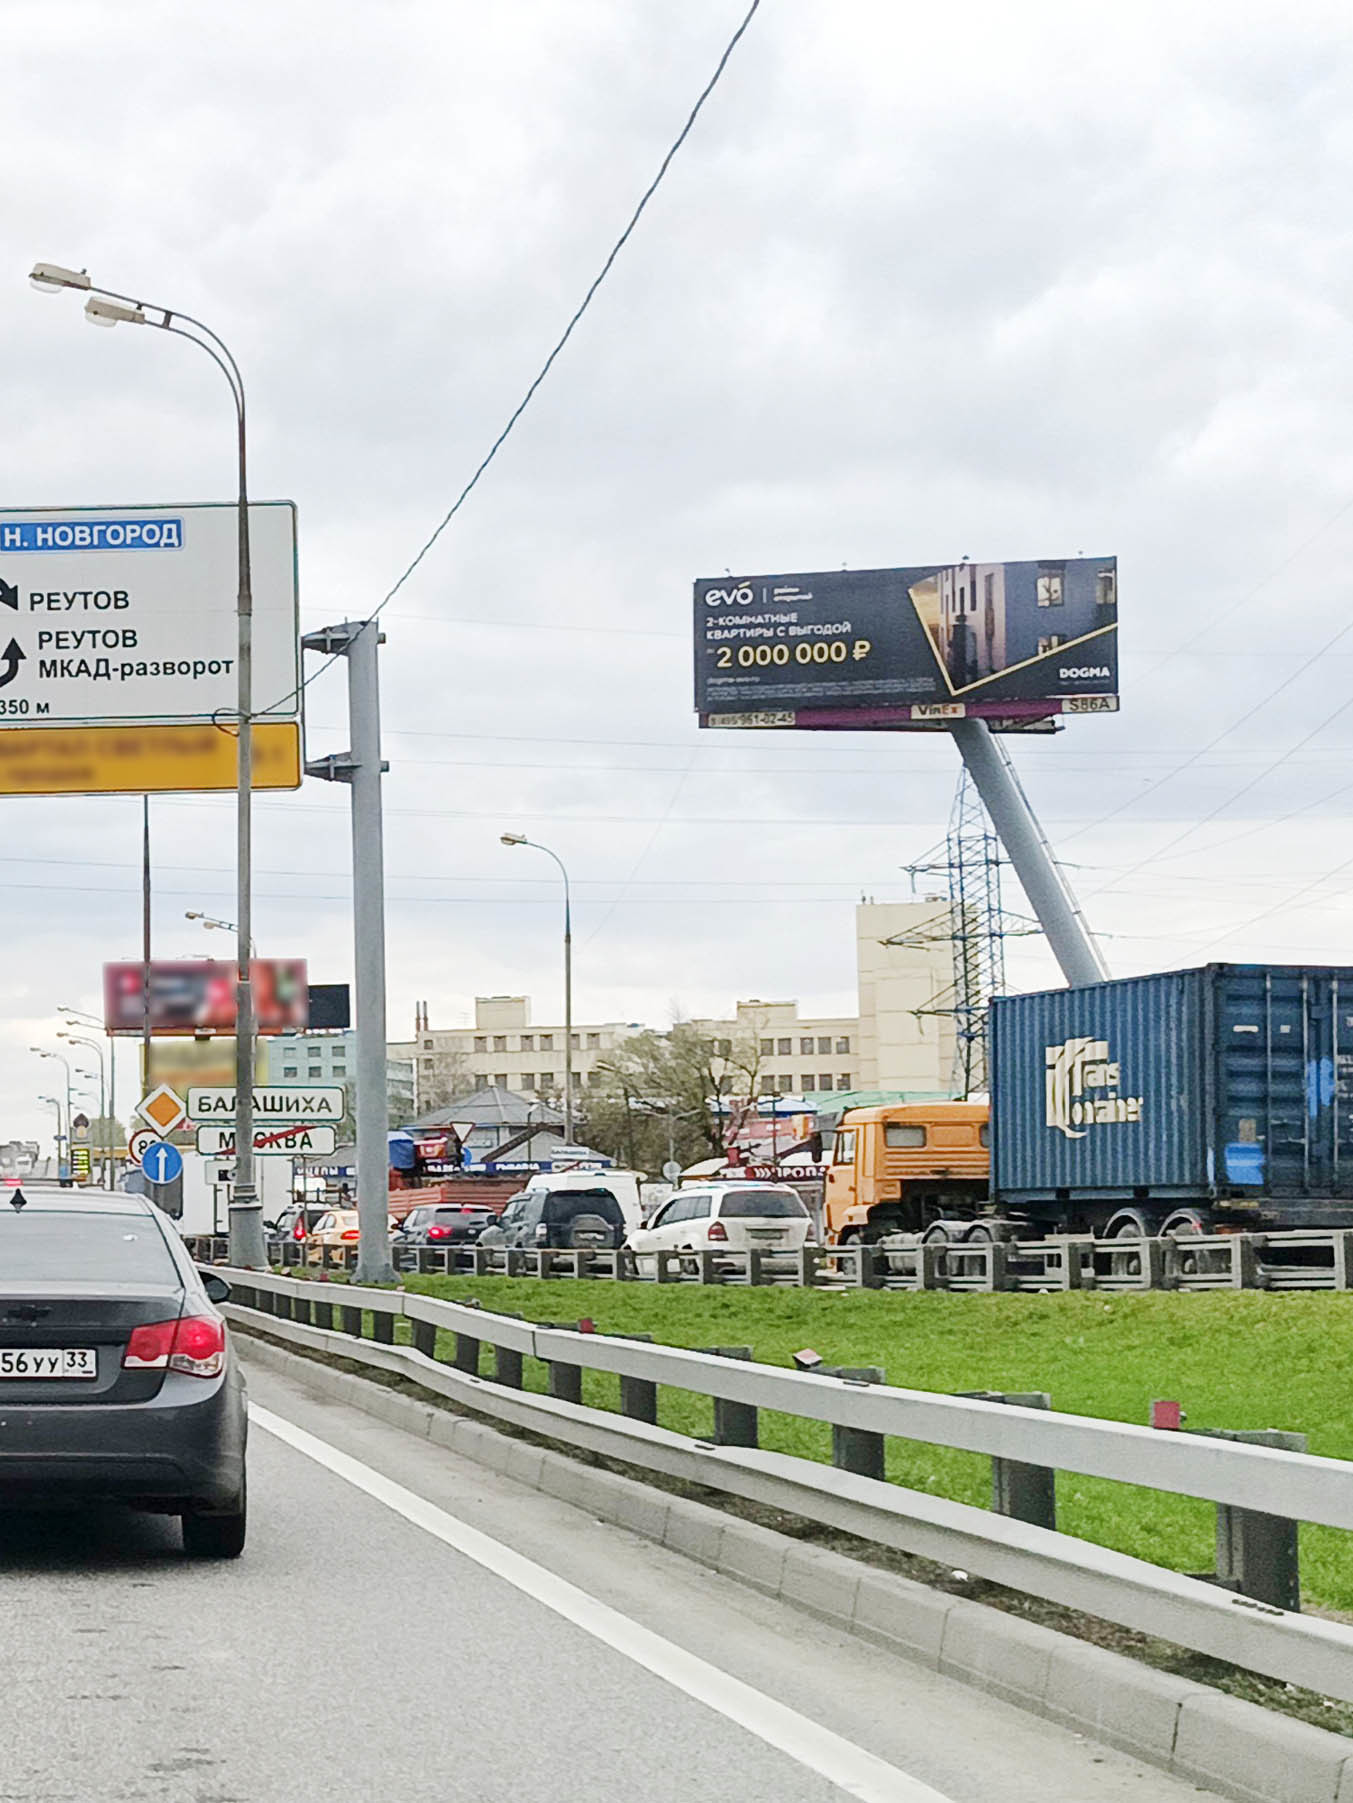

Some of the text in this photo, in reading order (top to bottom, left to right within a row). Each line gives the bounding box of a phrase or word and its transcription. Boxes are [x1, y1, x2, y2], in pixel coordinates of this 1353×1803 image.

[3, 522, 180, 548] Н. НОВГОРОД
[29, 590, 130, 612] РЕУТОВ
[706, 612, 799, 628] 2-КОМНАТНЫЕ
[38, 629, 138, 651] РЕУТОВ
[706, 628, 774, 640] КВАРТИРЫ
[788, 621, 852, 637] ВЫГОДОЙ
[716, 647, 733, 668] 2
[738, 643, 790, 668] 000
[795, 641, 848, 665] 000
[38, 657, 235, 682] МКАД-разворот
[1059, 666, 1111, 679] DOGMA
[36, 701, 50, 714] м
[219, 1131, 313, 1150] МСКВА
